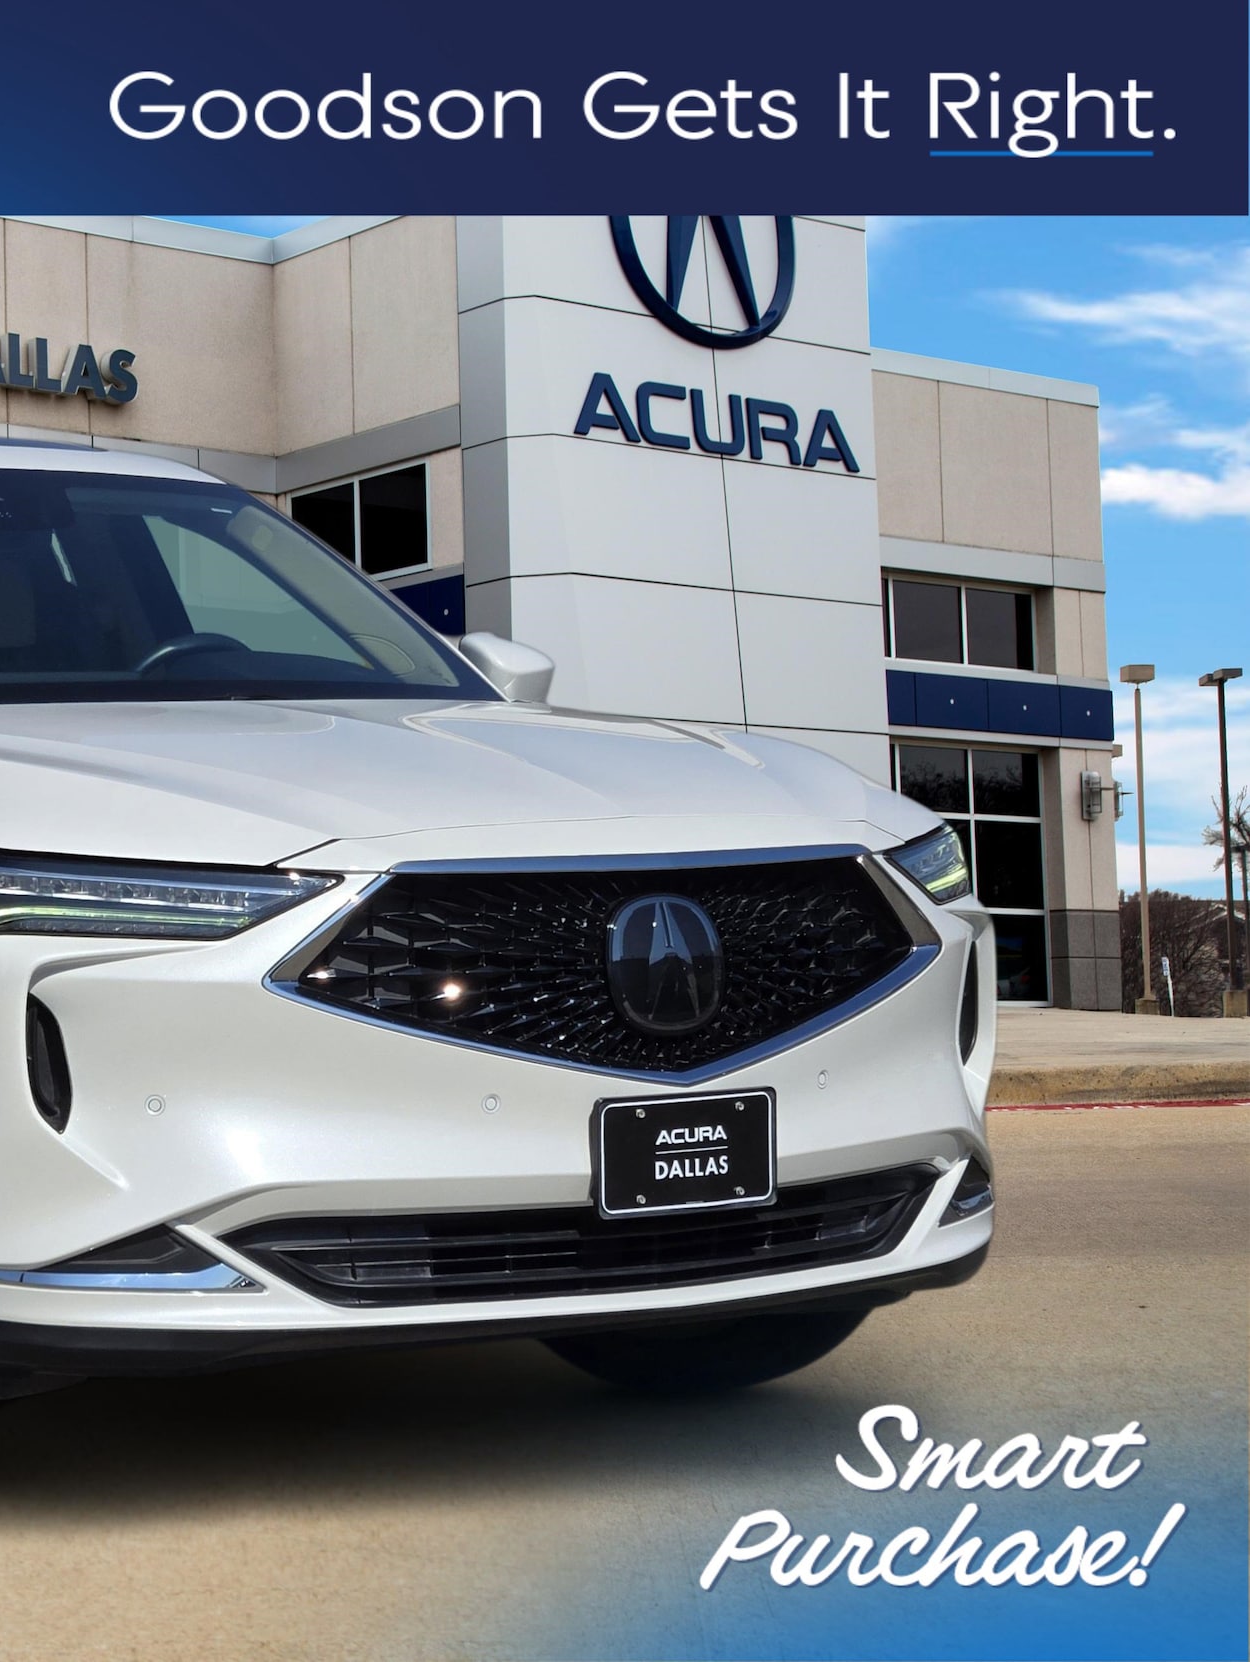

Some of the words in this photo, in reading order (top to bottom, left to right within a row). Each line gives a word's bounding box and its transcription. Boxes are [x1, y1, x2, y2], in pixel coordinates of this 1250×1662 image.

[573, 372, 860, 473] ACURA
[655, 1125, 728, 1146] ACURA
[654, 1155, 729, 1181] DALLAS
